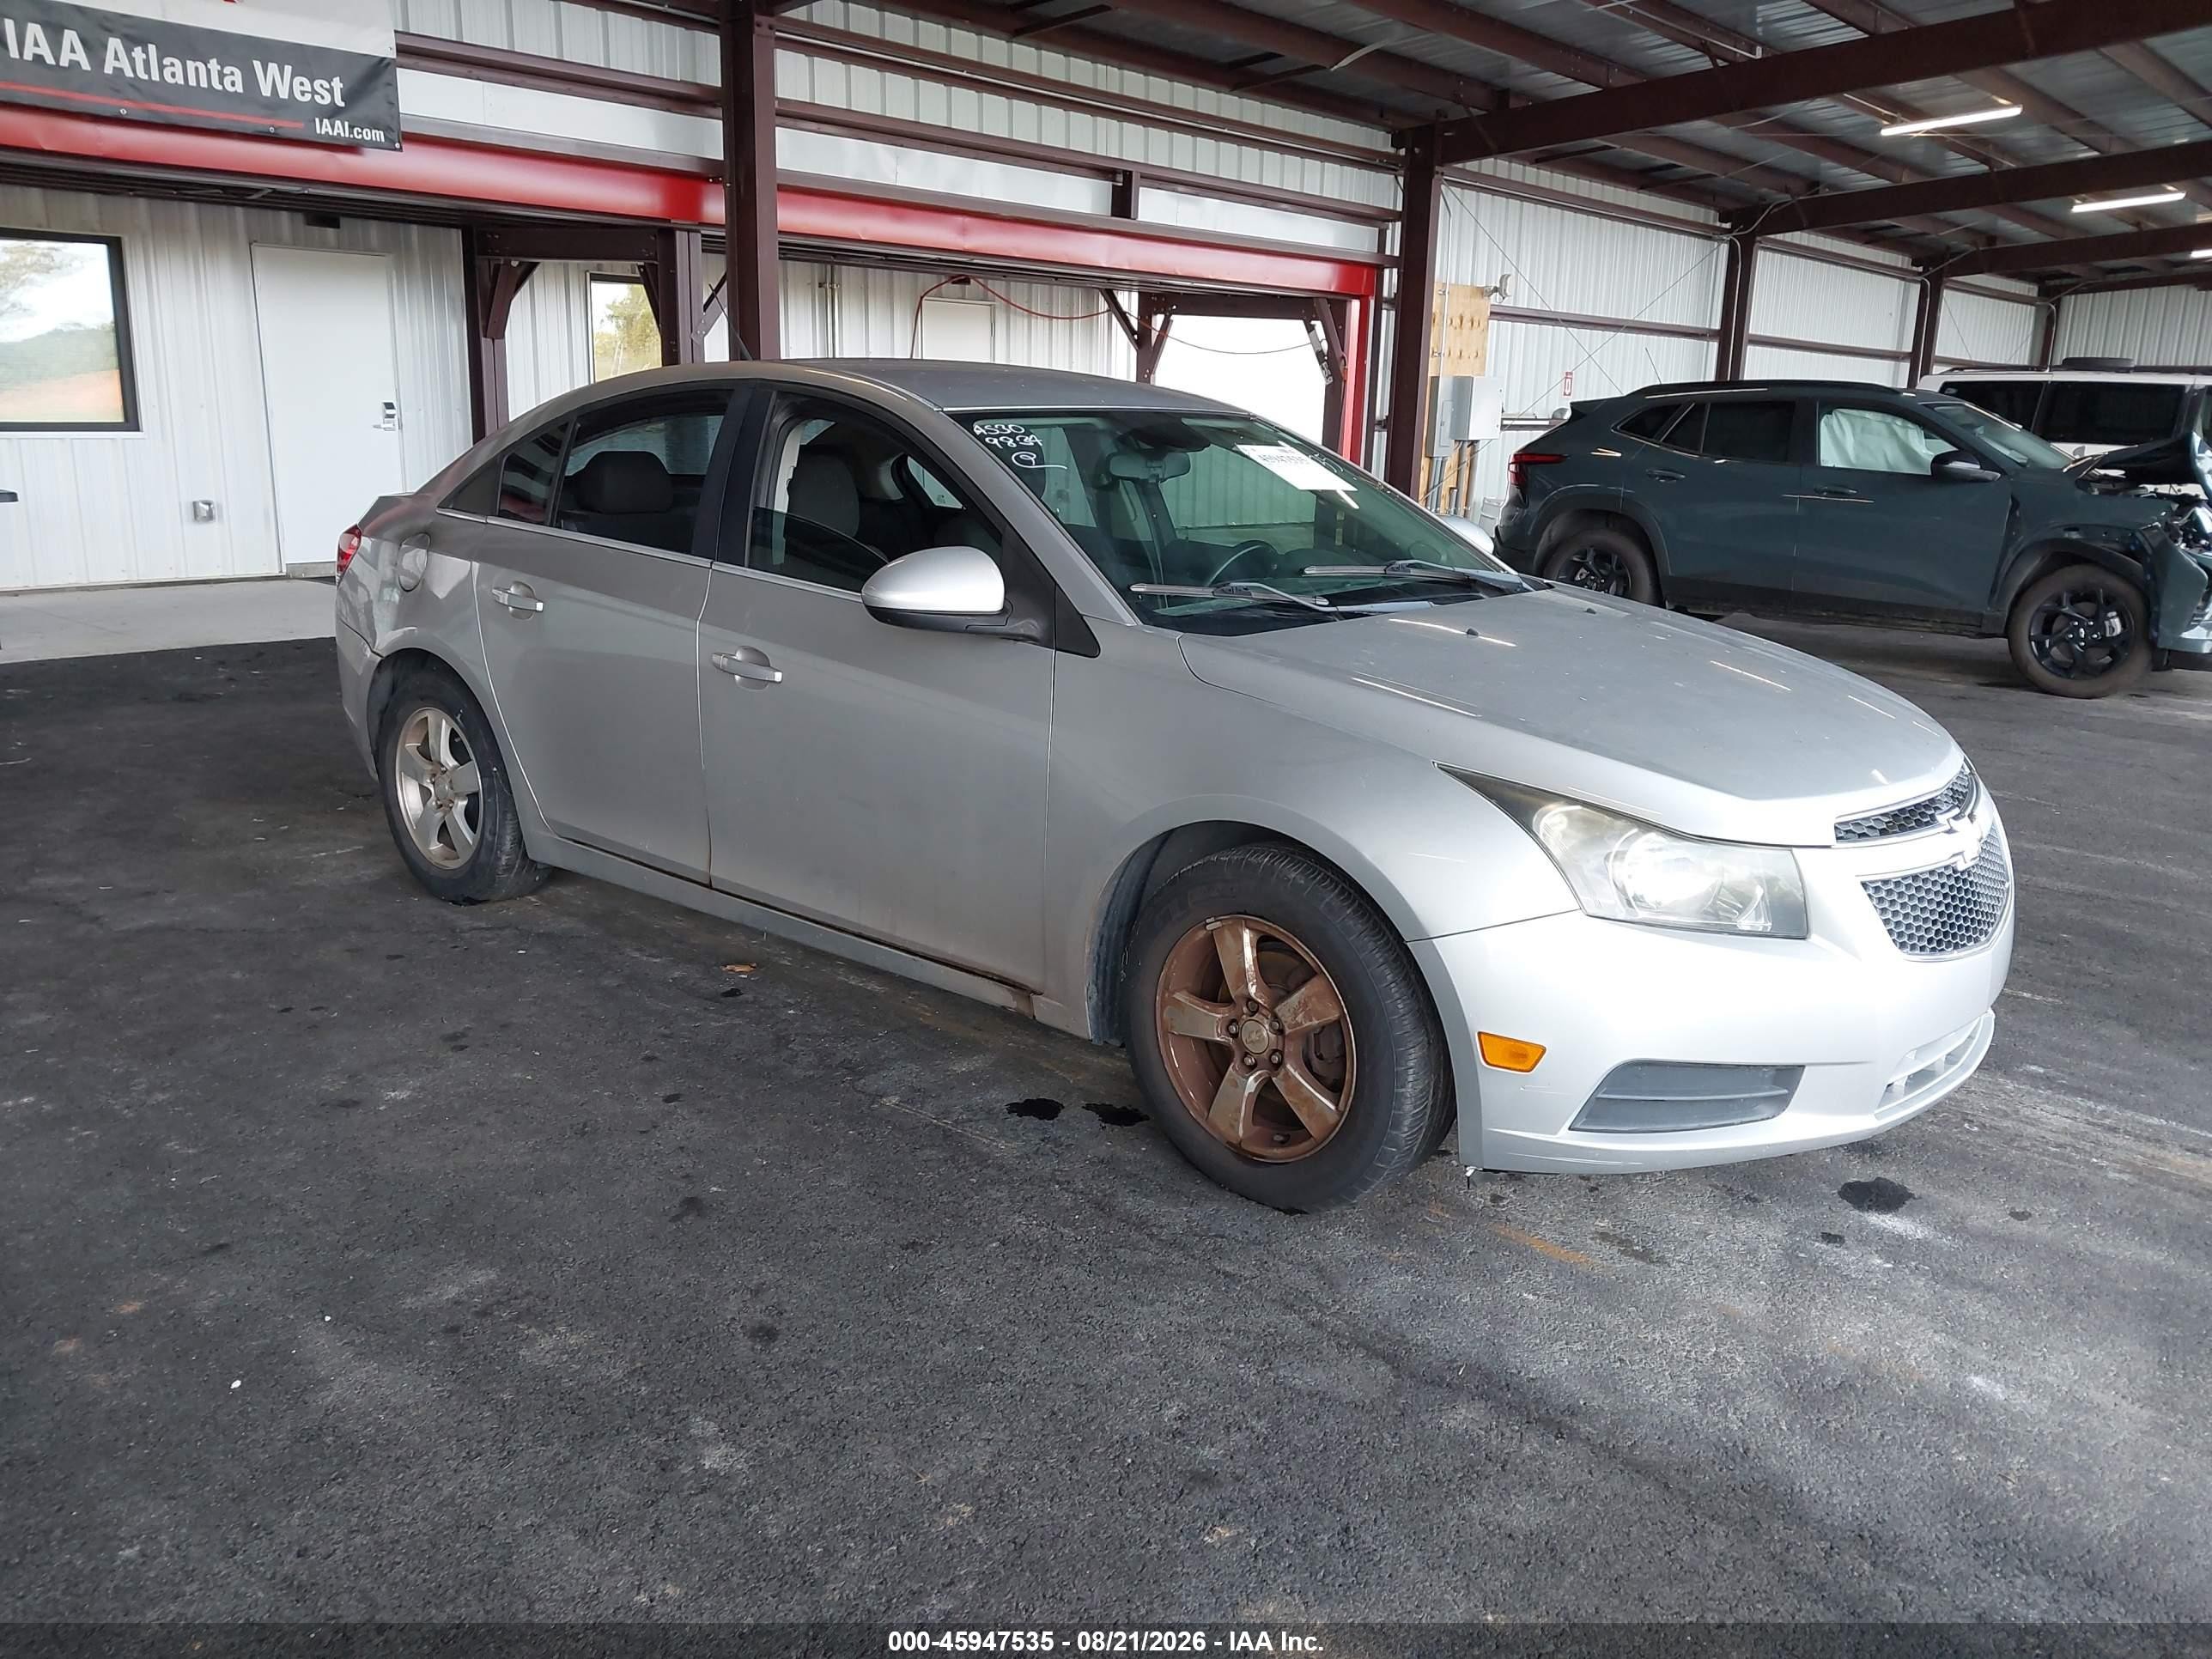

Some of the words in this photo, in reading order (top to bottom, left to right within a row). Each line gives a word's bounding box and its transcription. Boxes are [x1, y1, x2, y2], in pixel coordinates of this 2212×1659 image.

[3, 18, 92, 71] IAA
[103, 37, 244, 94] Atlanta
[252, 59, 345, 107] West
[314, 117, 385, 143] IAAI.com
